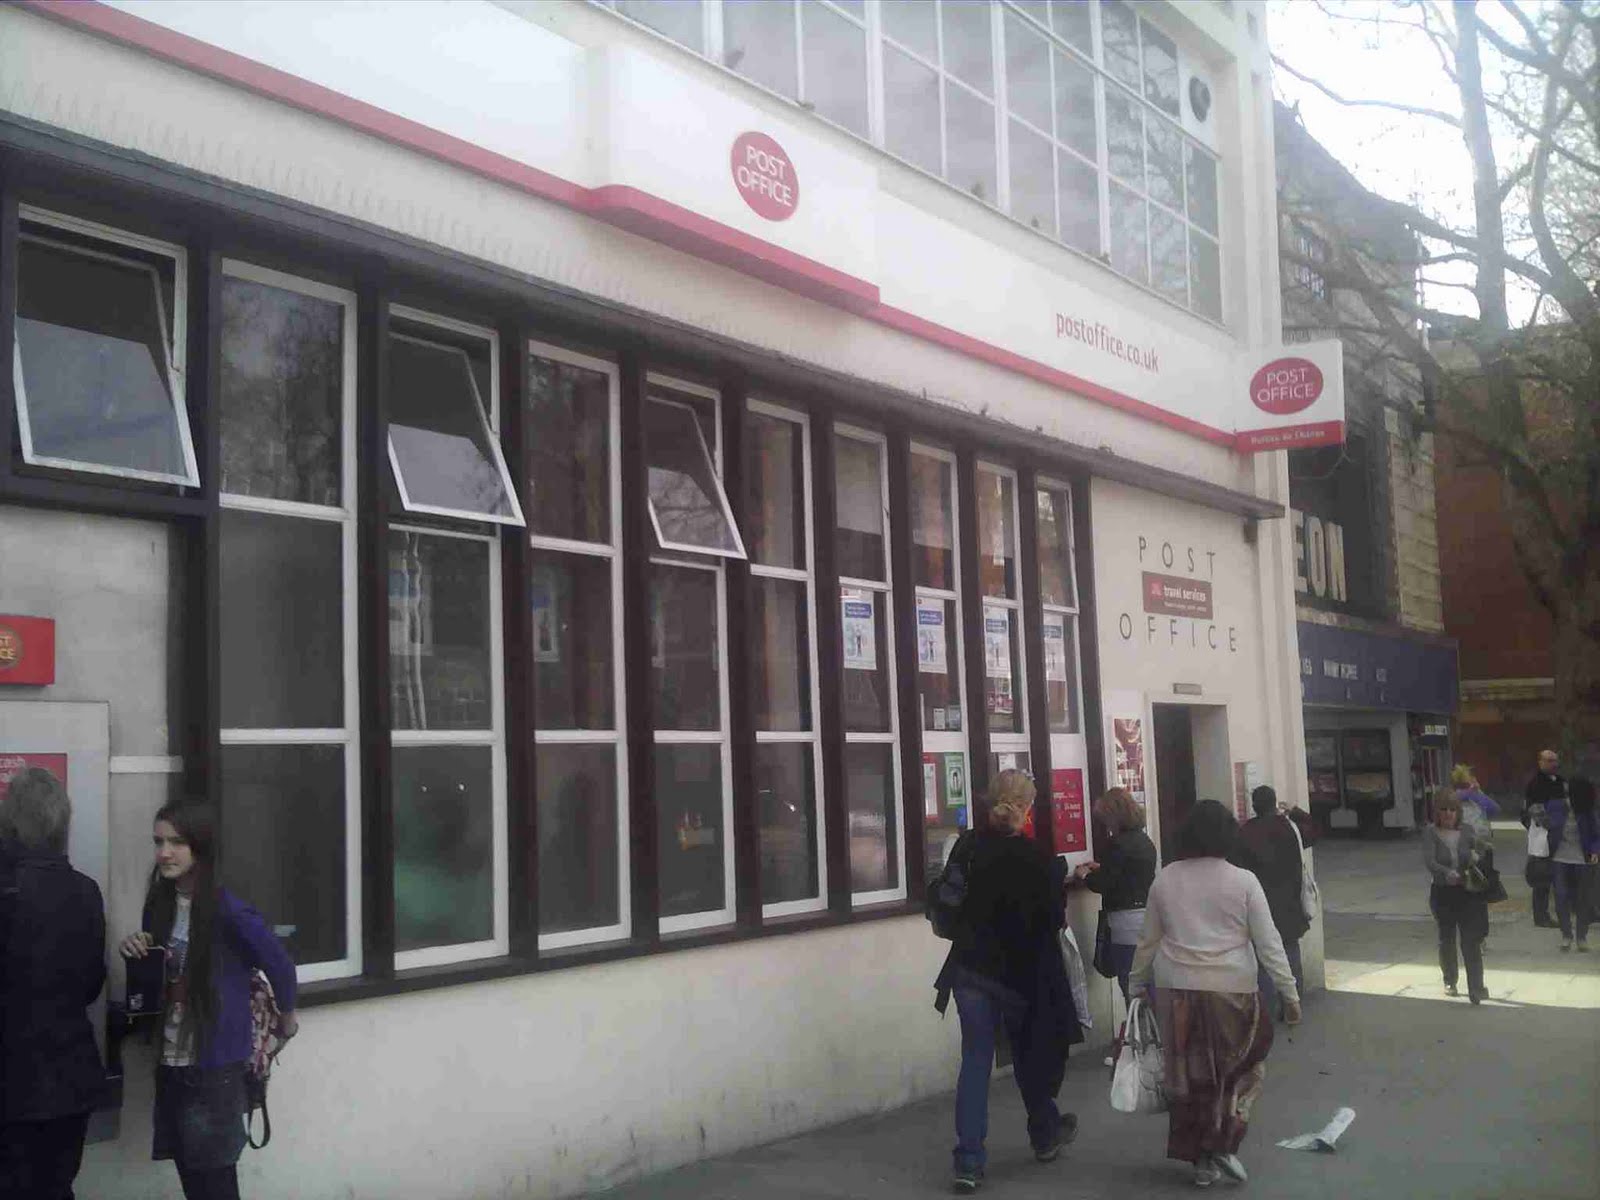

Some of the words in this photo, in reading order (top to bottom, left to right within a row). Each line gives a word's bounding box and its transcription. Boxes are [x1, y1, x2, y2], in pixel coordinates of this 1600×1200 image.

[745, 143, 786, 181] POST
[737, 164, 793, 208] OFFICE
[1056, 312, 1159, 373] postoffice.co.uk
[1256, 382, 1315, 403] OFFICE
[1266, 367, 1308, 386] POST
[1138, 535, 1216, 580] POST
[1119, 612, 1237, 653] OFFICE
